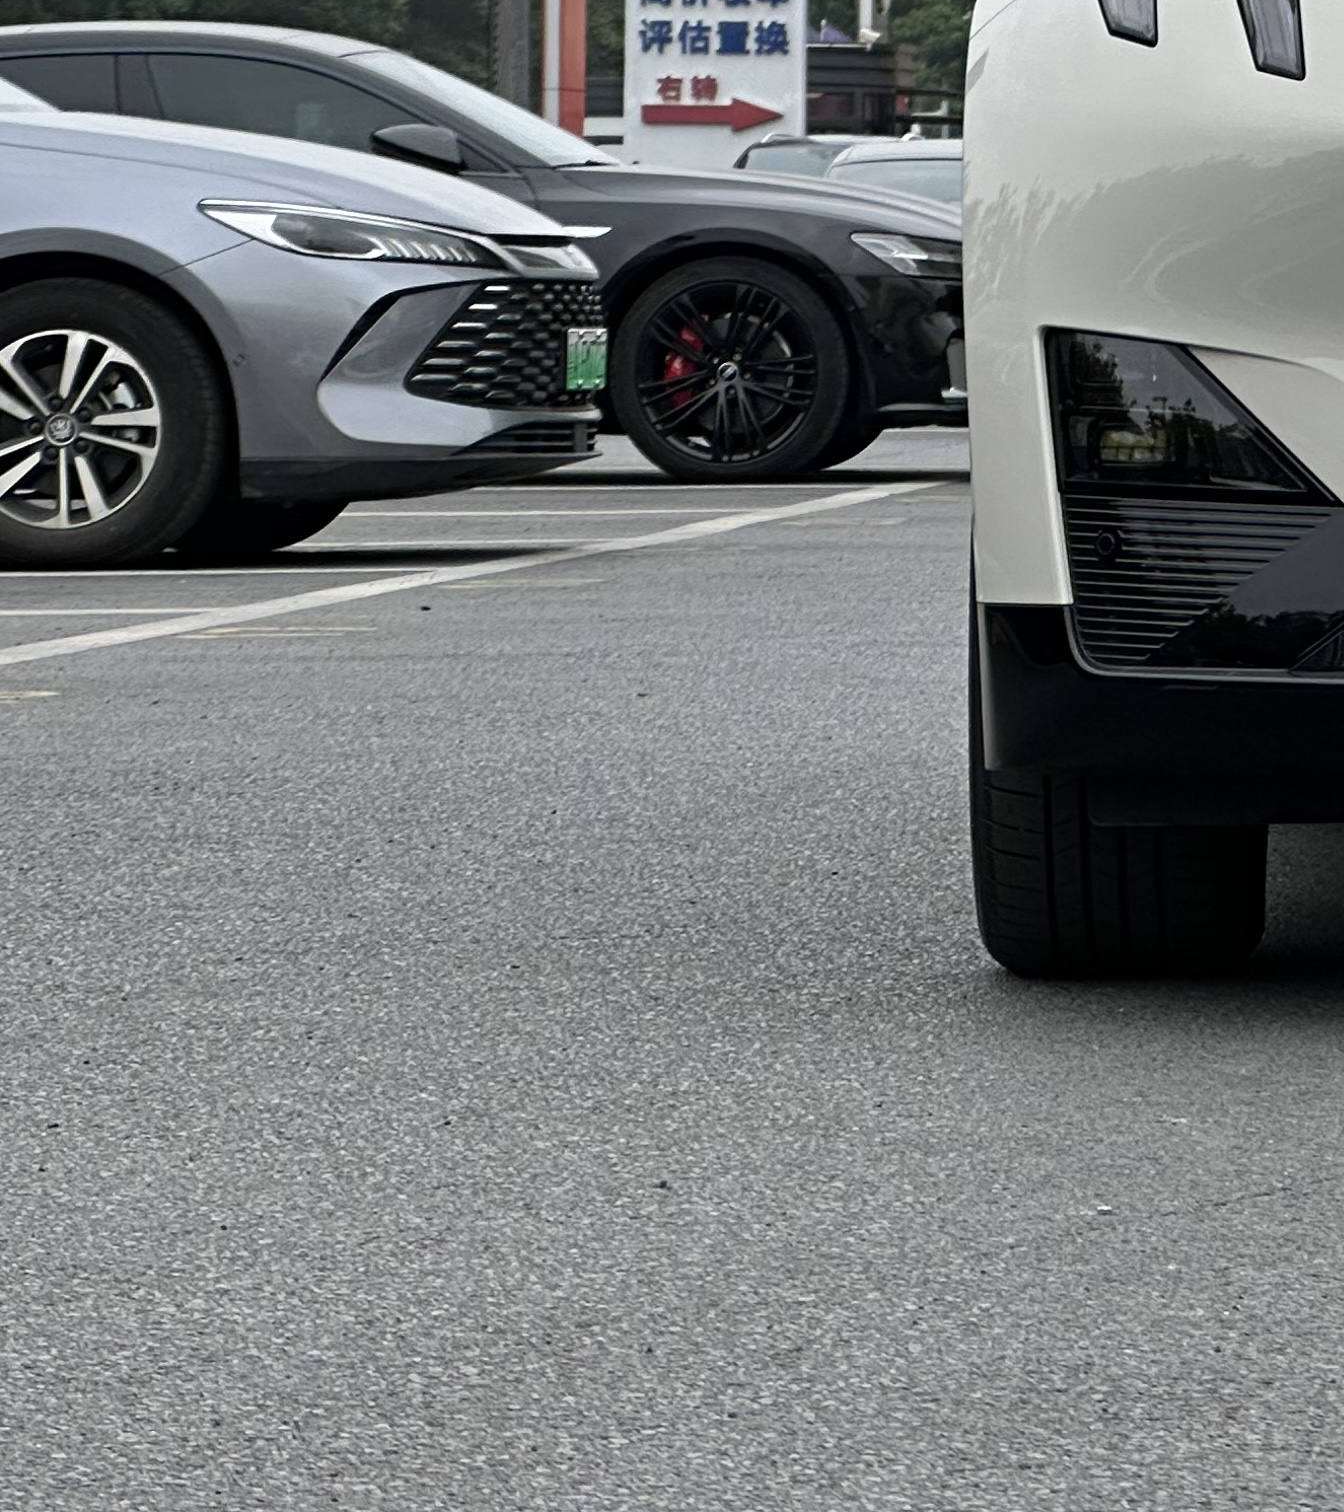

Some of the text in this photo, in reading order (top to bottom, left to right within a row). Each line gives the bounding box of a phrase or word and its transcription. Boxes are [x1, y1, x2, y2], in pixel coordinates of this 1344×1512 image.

[639, 19, 791, 57] 评估置换
[656, 74, 720, 102] 右转
